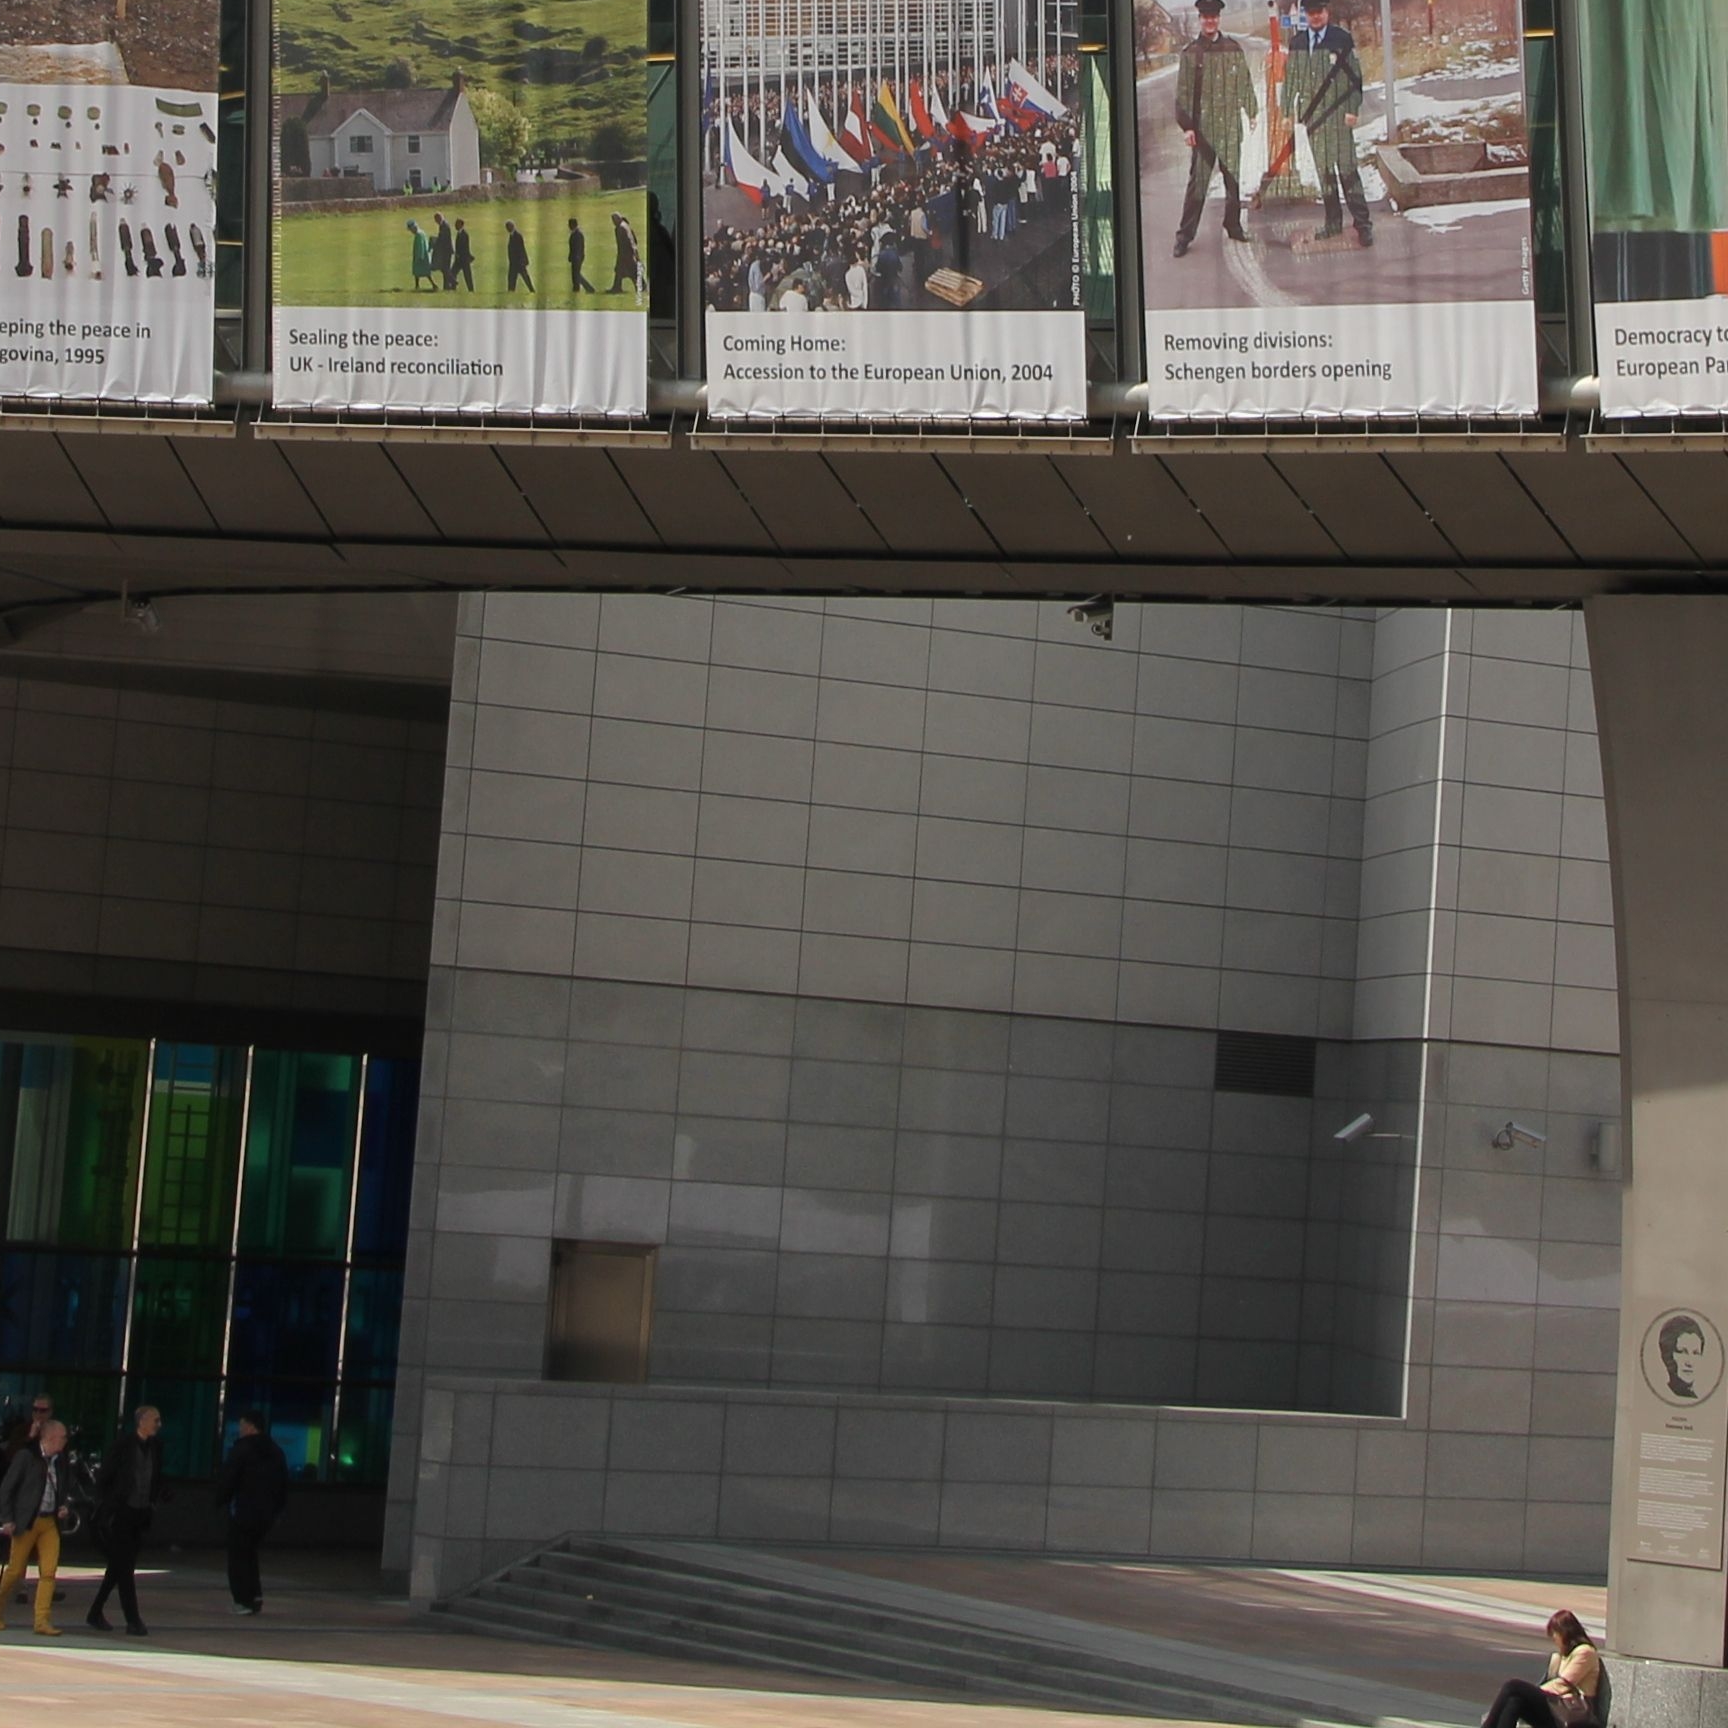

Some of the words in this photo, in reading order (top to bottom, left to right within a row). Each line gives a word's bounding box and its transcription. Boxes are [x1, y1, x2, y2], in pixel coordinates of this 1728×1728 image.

[1069, 171, 1078, 192] 2004
[1070, 194, 1079, 220] Union
[1070, 221, 1081, 263] European
[1519, 236, 1531, 268] Images
[635, 261, 646, 306] WireImage
[1071, 274, 1081, 306] PHOTO
[1520, 270, 1531, 295] Getty
[49, 319, 76, 336] the
[82, 325, 131, 340] peace
[136, 323, 150, 339] in
[289, 329, 348, 349] Sealing
[352, 329, 379, 346] the
[385, 334, 438, 349] peace:
[1615, 329, 1712, 347] Democracy
[723, 335, 786, 355] Coming
[791, 335, 845, 351] Home:
[1165, 332, 1248, 353] Removing
[1254, 331, 1332, 349] divisions:
[65, 348, 105, 365] 1995
[290, 357, 313, 372] UK
[329, 357, 385, 373] Ireland
[391, 358, 503, 376] reconciliation
[724, 363, 804, 379] Accession
[809, 365, 826, 380] to
[831, 363, 859, 380] the
[864, 364, 944, 384] European
[951, 362, 1006, 384] Union,
[1011, 364, 1053, 381] 2004
[1165, 362, 1245, 383] Schengen
[1252, 360, 1316, 379] borders
[1321, 359, 1391, 382] opening
[1617, 359, 1699, 379] European
